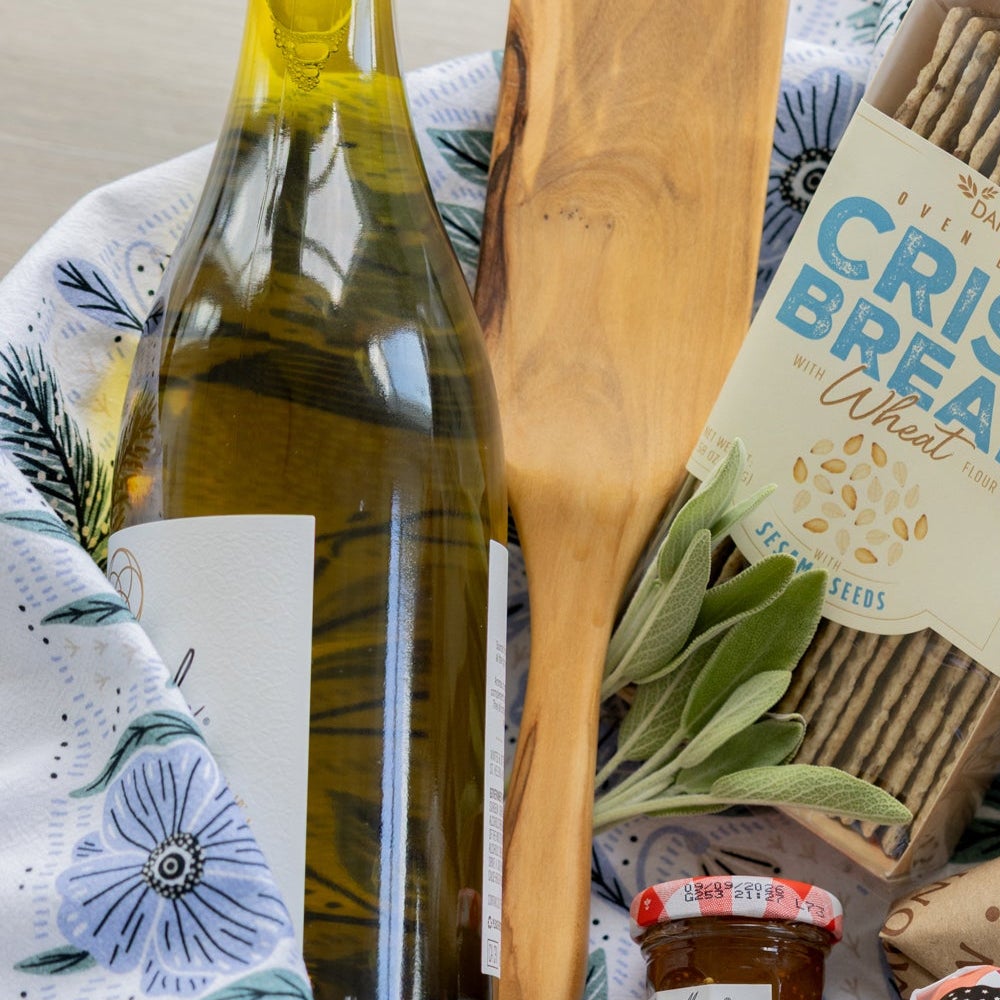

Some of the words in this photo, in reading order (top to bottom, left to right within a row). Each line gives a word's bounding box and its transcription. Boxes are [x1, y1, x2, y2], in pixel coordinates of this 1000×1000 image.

[898, 191, 971, 247] OVEN
[792, 353, 826, 382] WITH
[819, 364, 977, 462] Wheat
[961, 461, 999, 495] FLOUR
[813, 548, 842, 570] WITH
[828, 577, 886, 611] SEEDS
